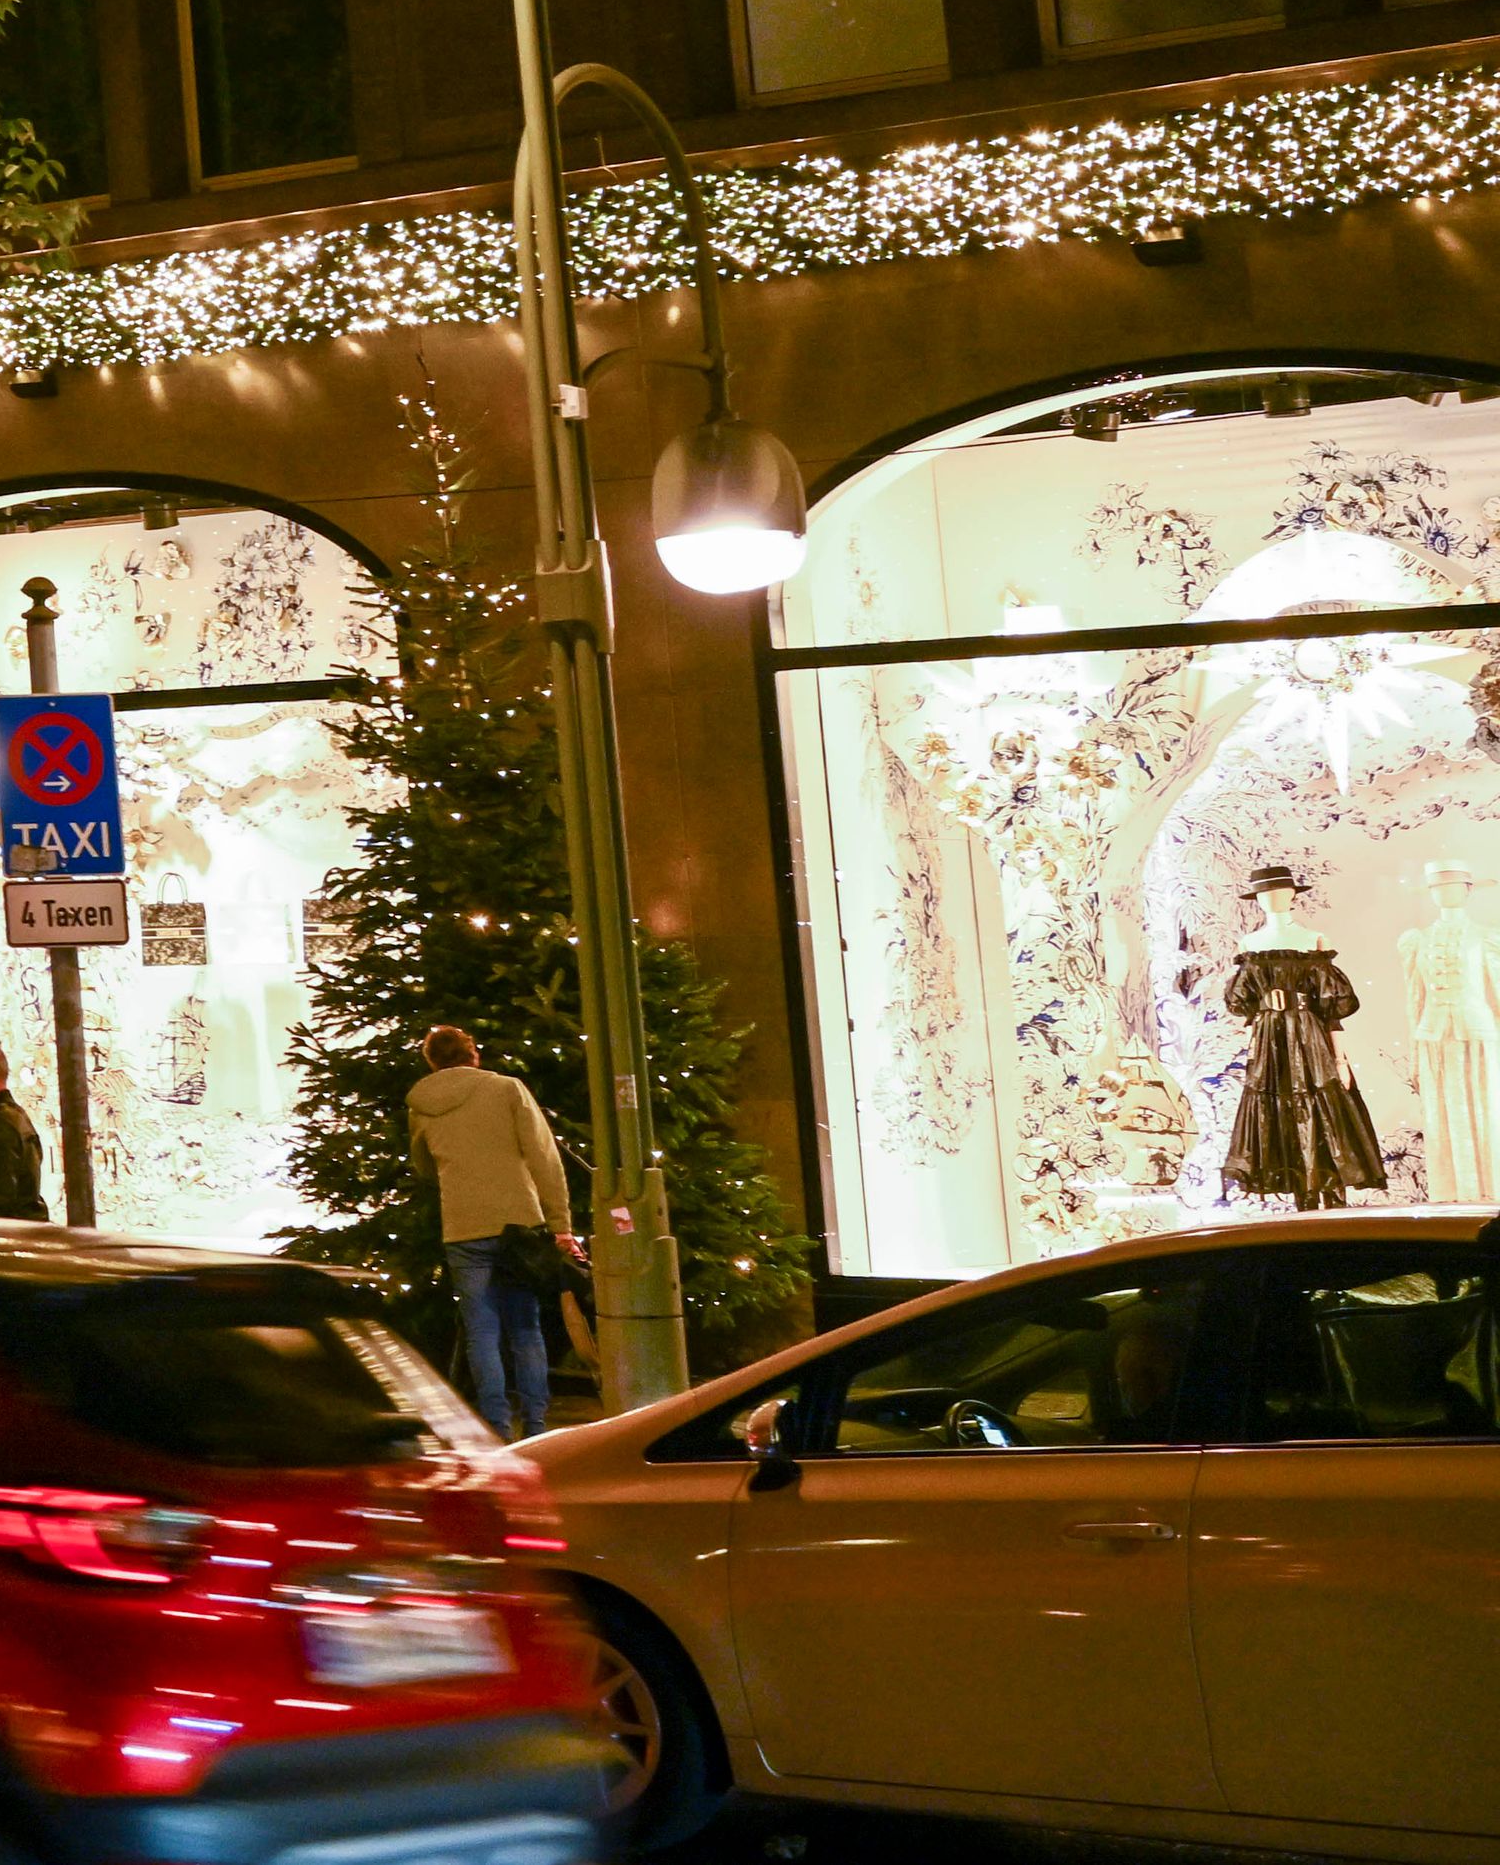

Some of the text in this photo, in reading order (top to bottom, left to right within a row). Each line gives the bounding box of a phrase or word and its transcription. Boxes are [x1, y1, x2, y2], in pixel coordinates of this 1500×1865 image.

[12, 821, 111, 859] TAXI
[21, 899, 113, 927] 4 Taxen
